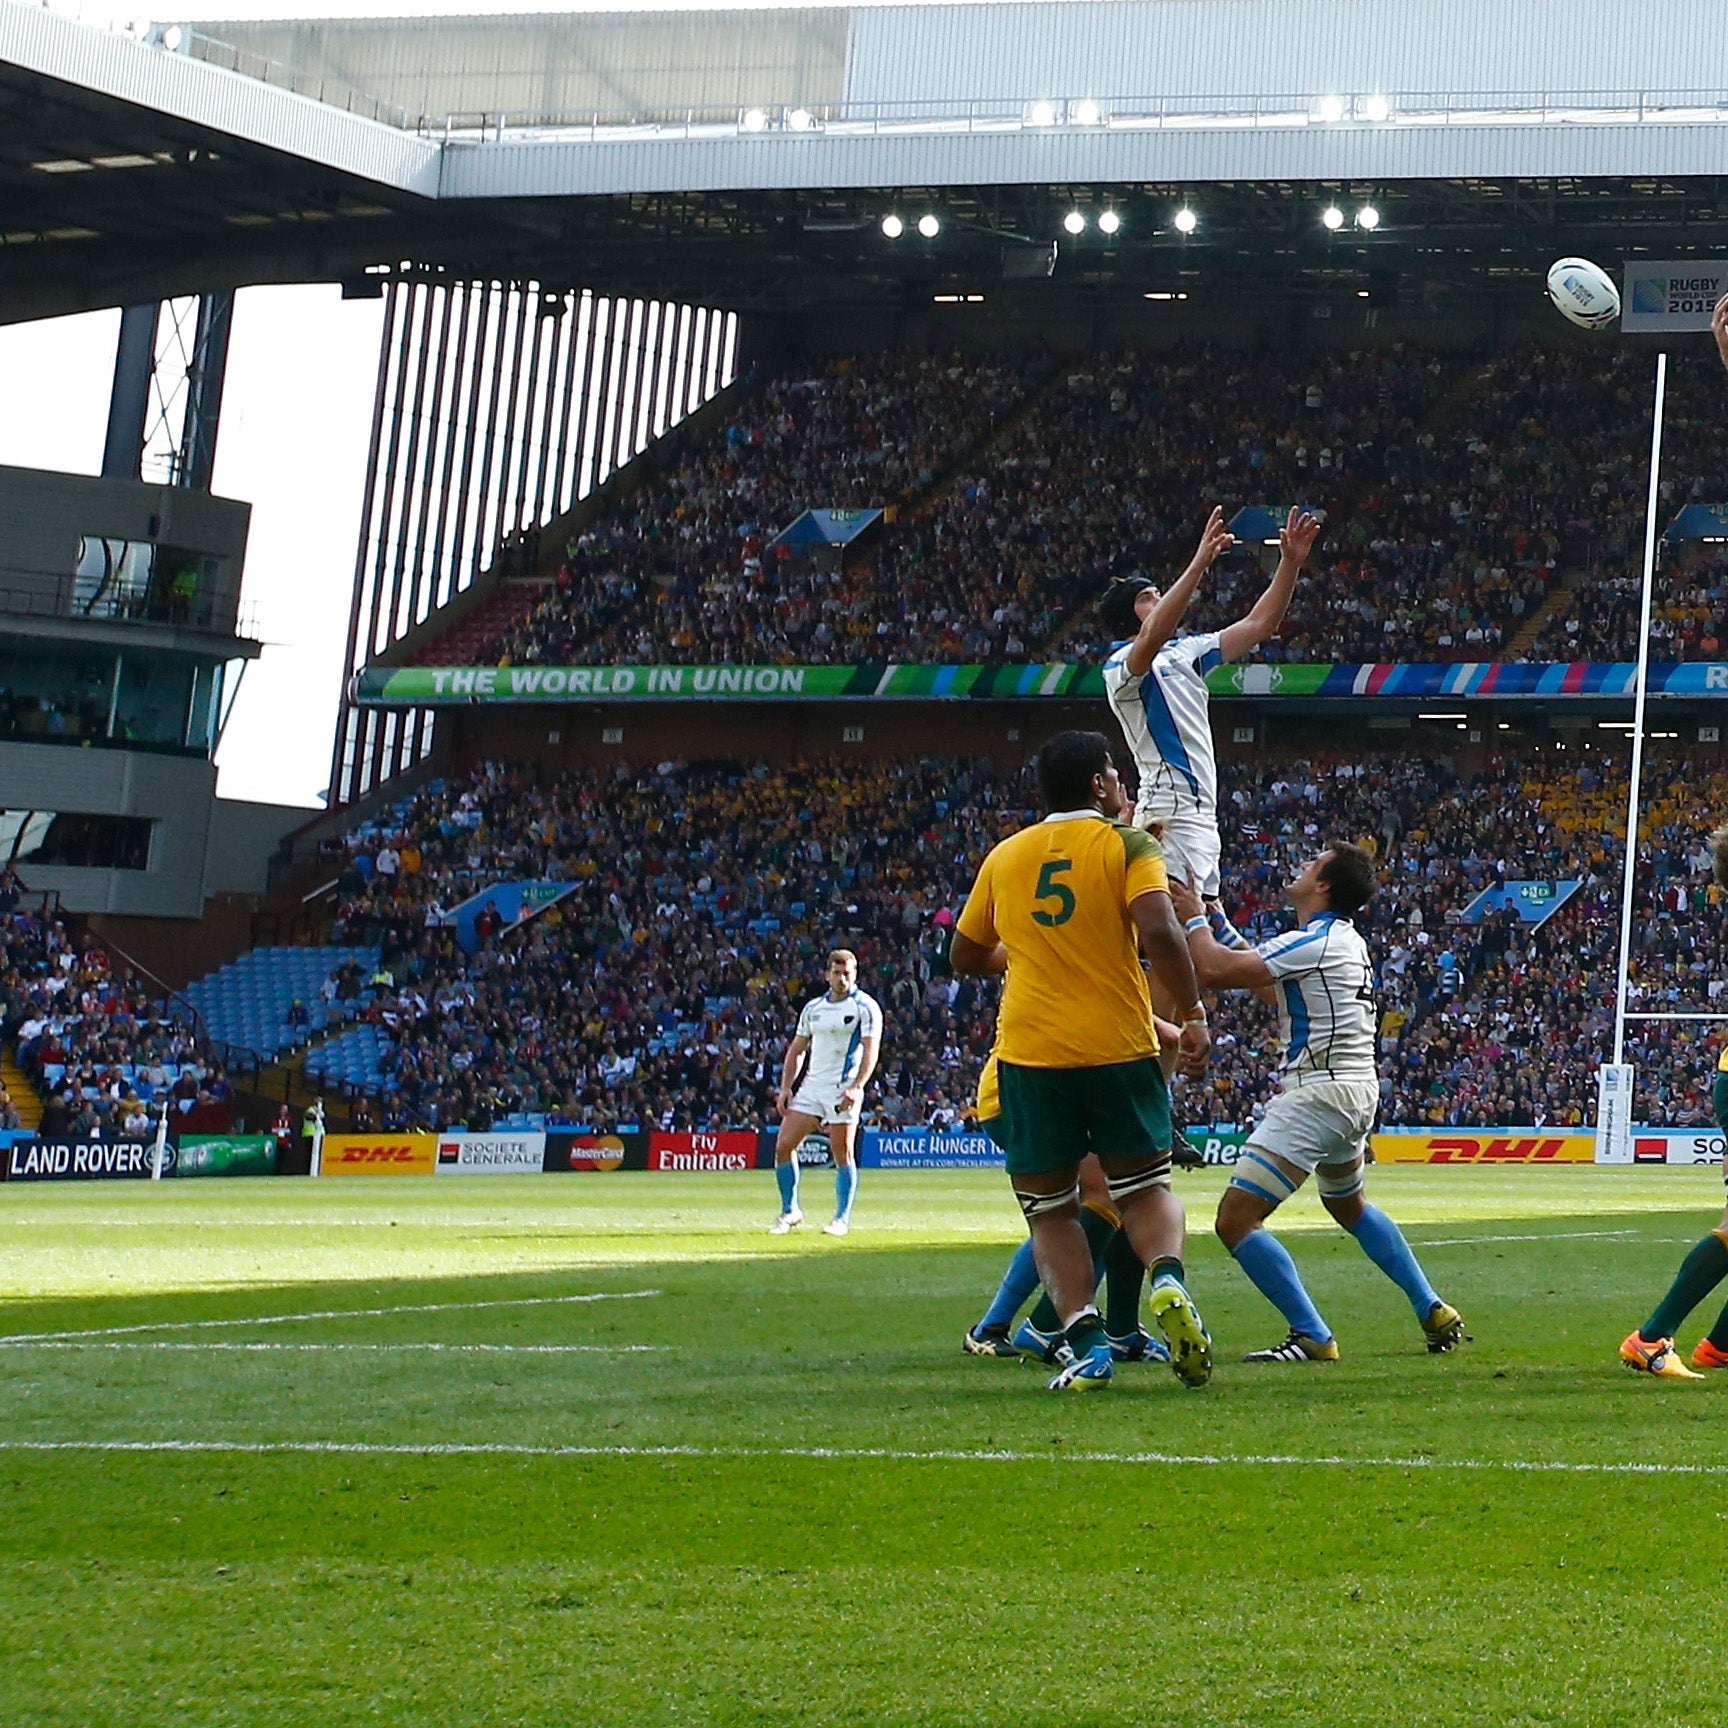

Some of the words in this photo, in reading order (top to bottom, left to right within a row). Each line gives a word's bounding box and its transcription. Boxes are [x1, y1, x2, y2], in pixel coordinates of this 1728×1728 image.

[1669, 278, 1719, 291] RUGBY
[1669, 300, 1716, 313] 2015
[432, 671, 498, 693] THE
[511, 670, 635, 693] WORLD
[648, 669, 682, 692] IN
[692, 669, 805, 692] UNION
[1031, 859, 1076, 927] 5
[571, 1146, 625, 1160] MasterCard
[691, 1134, 717, 1152] Fly
[877, 1137, 926, 1155] TACKLE
[930, 1136, 987, 1156] HUNGER
[1426, 1139, 1566, 1163] DHL
[11, 1145, 69, 1174] LAND
[74, 1144, 143, 1172] ROVER
[341, 1146, 415, 1163] DHL
[659, 1150, 747, 1170] Emirates
